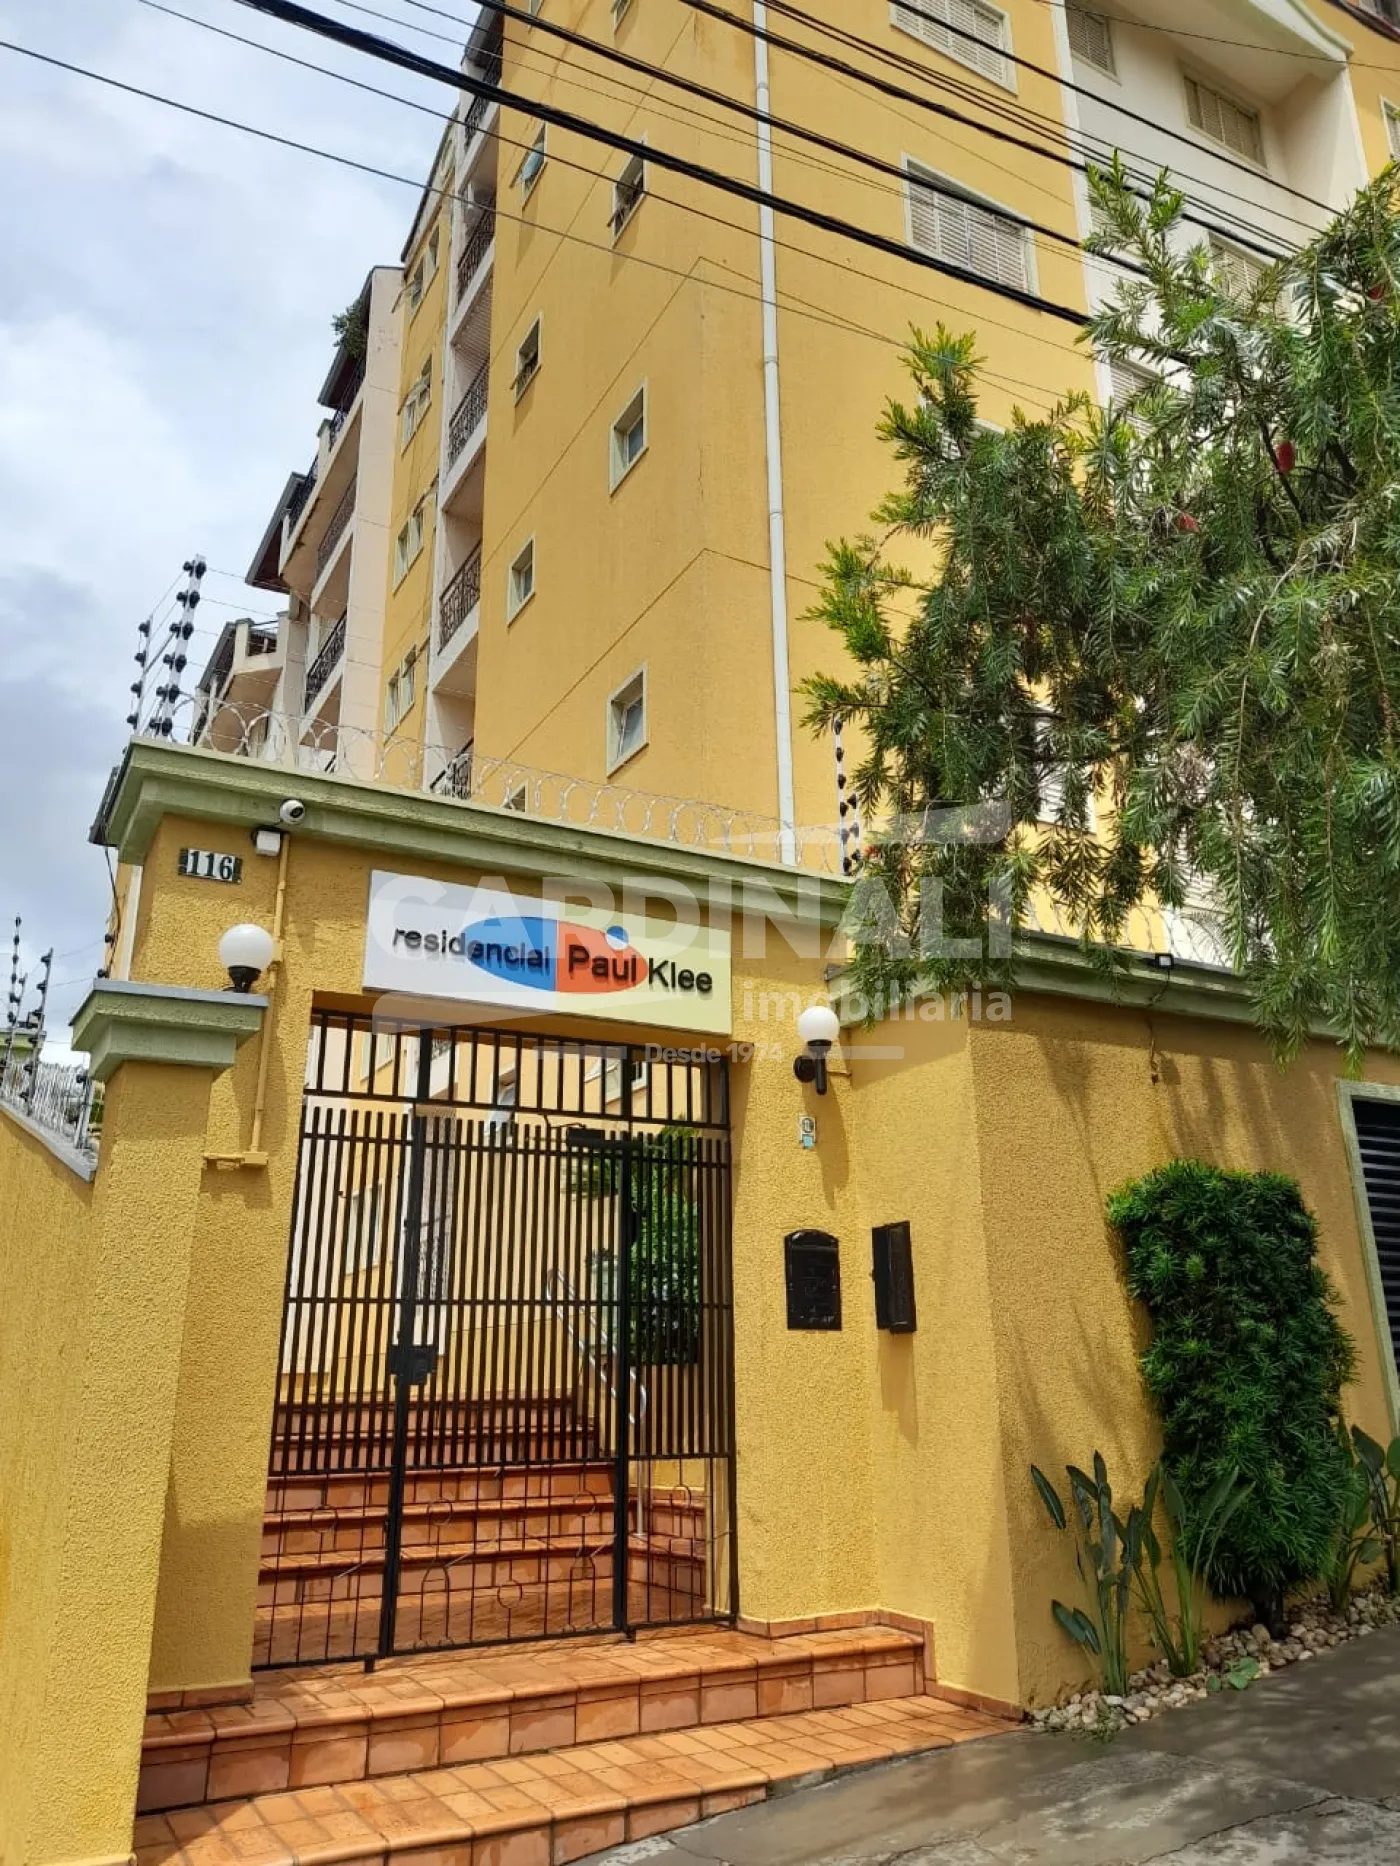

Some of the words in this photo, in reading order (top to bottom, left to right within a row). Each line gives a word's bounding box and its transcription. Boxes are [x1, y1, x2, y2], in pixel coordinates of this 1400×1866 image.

[189, 850, 233, 880] 116
[392, 926, 551, 977] residencial
[567, 943, 638, 983] Paul
[647, 958, 714, 994] Klee
